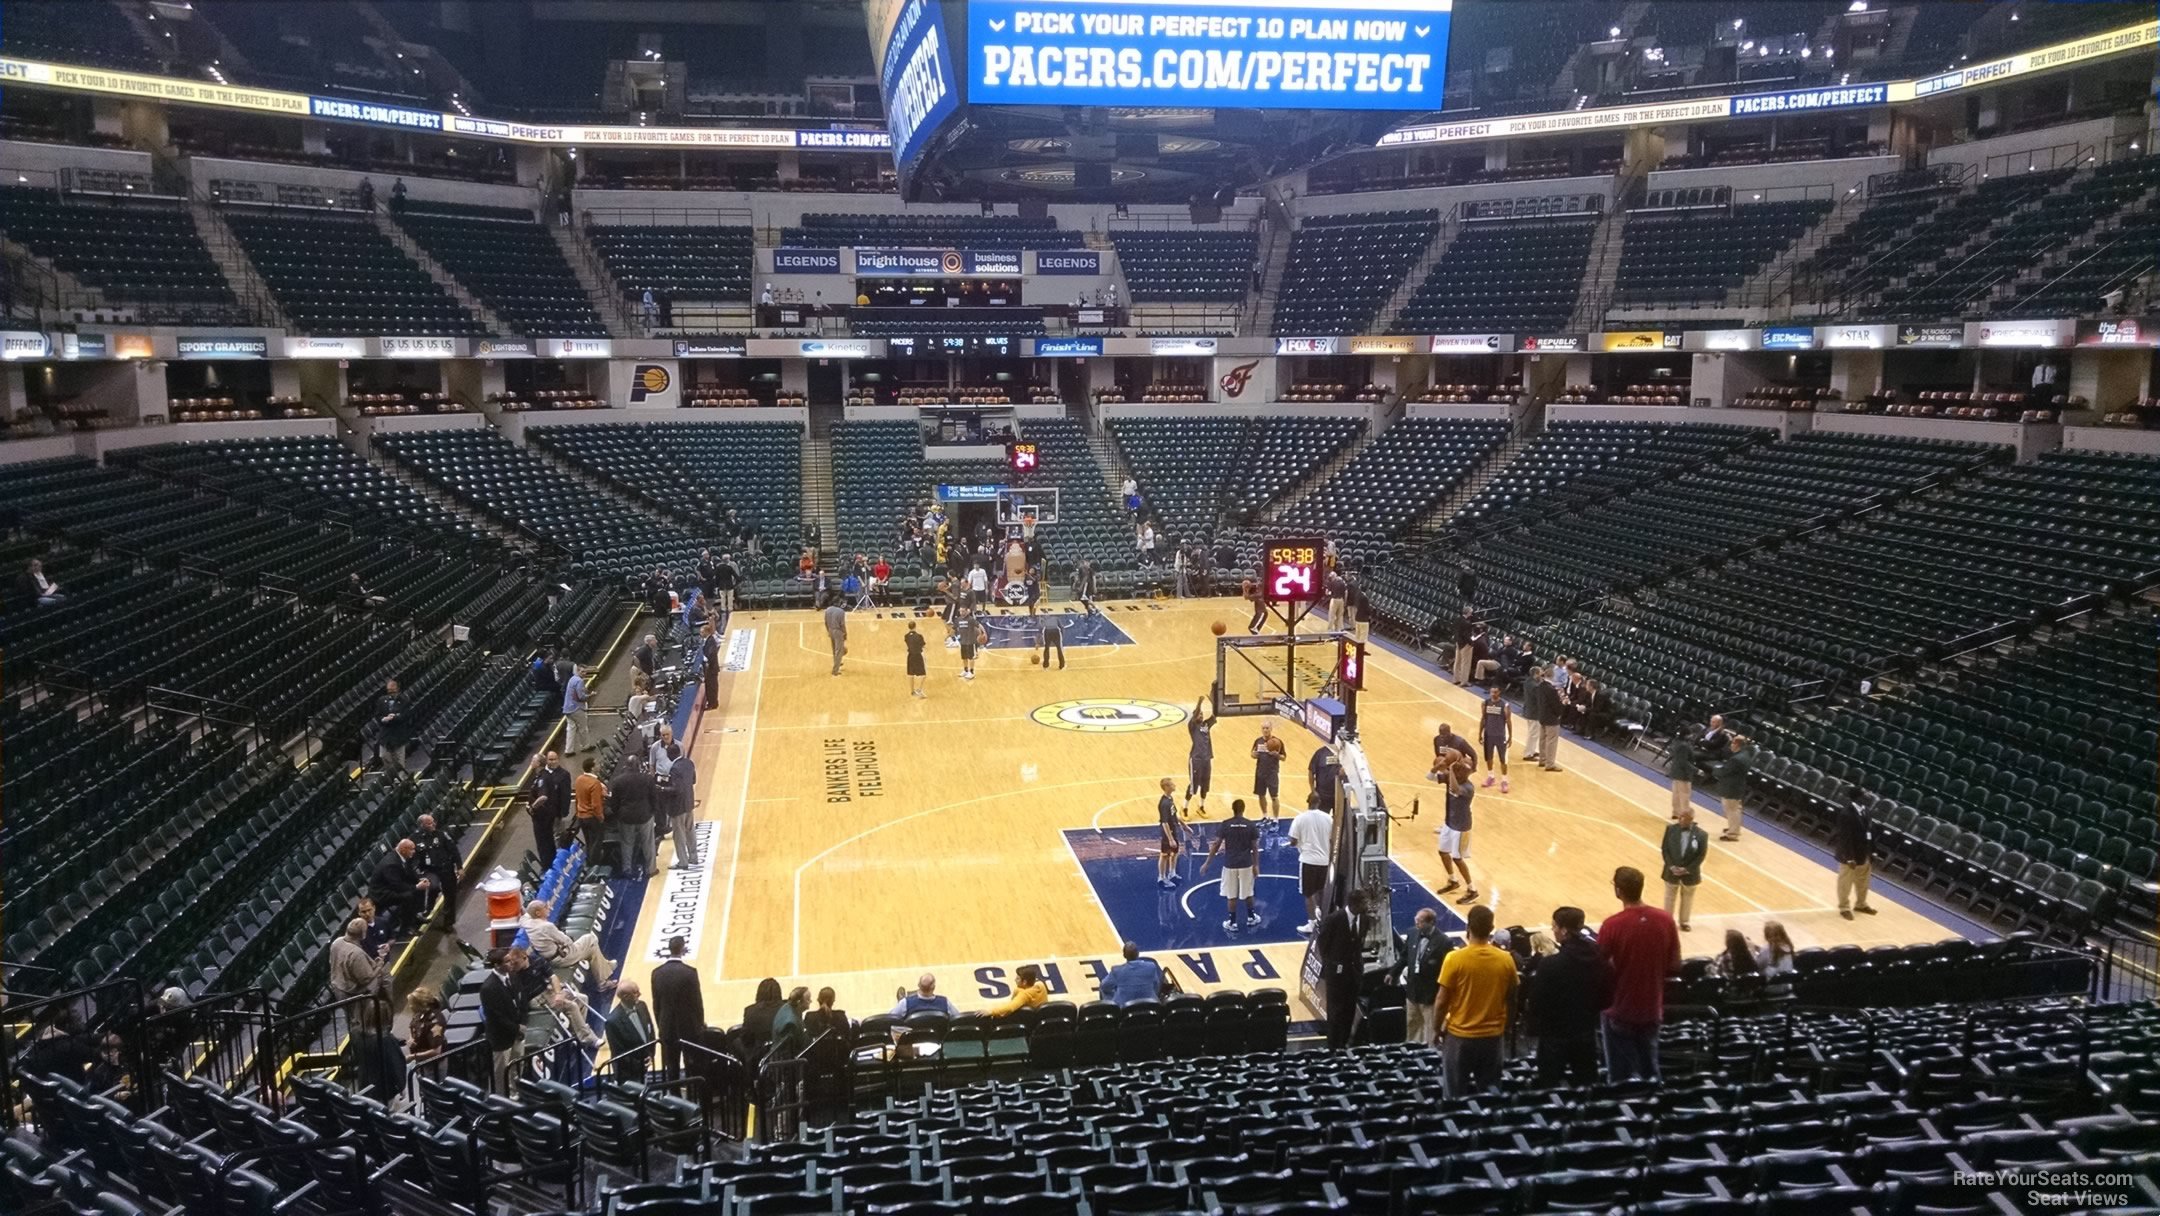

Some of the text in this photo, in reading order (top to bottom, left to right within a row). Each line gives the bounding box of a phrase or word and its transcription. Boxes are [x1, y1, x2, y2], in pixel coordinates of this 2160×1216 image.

[1015, 12, 1407, 41] PICK YOUR PERFECT 10 PLAN NOW
[2030, 53, 2046, 67] PICK
[2048, 49, 2066, 63] YOUR
[2067, 47, 2076, 59] 10
[2077, 38, 2113, 57] FAVORITE
[2114, 31, 2142, 47] GAMES
[983, 45, 1430, 93] PACERS.COM/PERFECT
[1965, 60, 2014, 83] PERFECT
[56, 71, 302, 110] PICK YOUR 10 FAVORITE GAMES FOR THE PERFECT 10 PLAN
[1735, 87, 1883, 114] PACERS.COM/PERFECT
[314, 99, 440, 128] PACERS.COM/PERFECT
[1509, 104, 1723, 132] PICK YOUR 10 FAVORITE GAMES FOR THE PERFECT 10 PLAN
[512, 126, 564, 139] PERFECT
[584, 131, 789, 144] PICK YOUR 10 FAVORITE GAMES FOR THE PERFECT 10 PLAN
[1440, 124, 1491, 138] PERFECT
[776, 256, 838, 267] LEGENDS
[859, 255, 939, 268] bright house
[975, 253, 1017, 262] business
[1039, 258, 1097, 268] LEGENDS
[975, 263, 1019, 272] solutions
[2098, 322, 2117, 333] the
[891, 338, 914, 346] PACERS
[1435, 338, 1459, 346] DRIVEN
[1460, 338, 1468, 346] TO
[1537, 338, 1577, 346] REPUBLIC
[1664, 335, 1681, 346] CAT
[1846, 330, 1870, 341] STAR
[2102, 332, 2121, 343] fan
[5, 338, 43, 350] DEFENDER
[179, 342, 265, 352] SPORT GRAPHICS
[309, 341, 344, 349] Community
[491, 343, 527, 351] LIGHTBOUND
[1041, 342, 1098, 351] Finish Line
[1288, 339, 1327, 351] FOX 59
[1017, 453, 1035, 467] 24
[1273, 548, 1314, 564] 59:38
[1275, 565, 1311, 595] 24
[824, 738, 851, 803] BANKERS LIFE
[853, 741, 884, 797] FIELDHOUSE
[974, 950, 1281, 1000] PAERS
